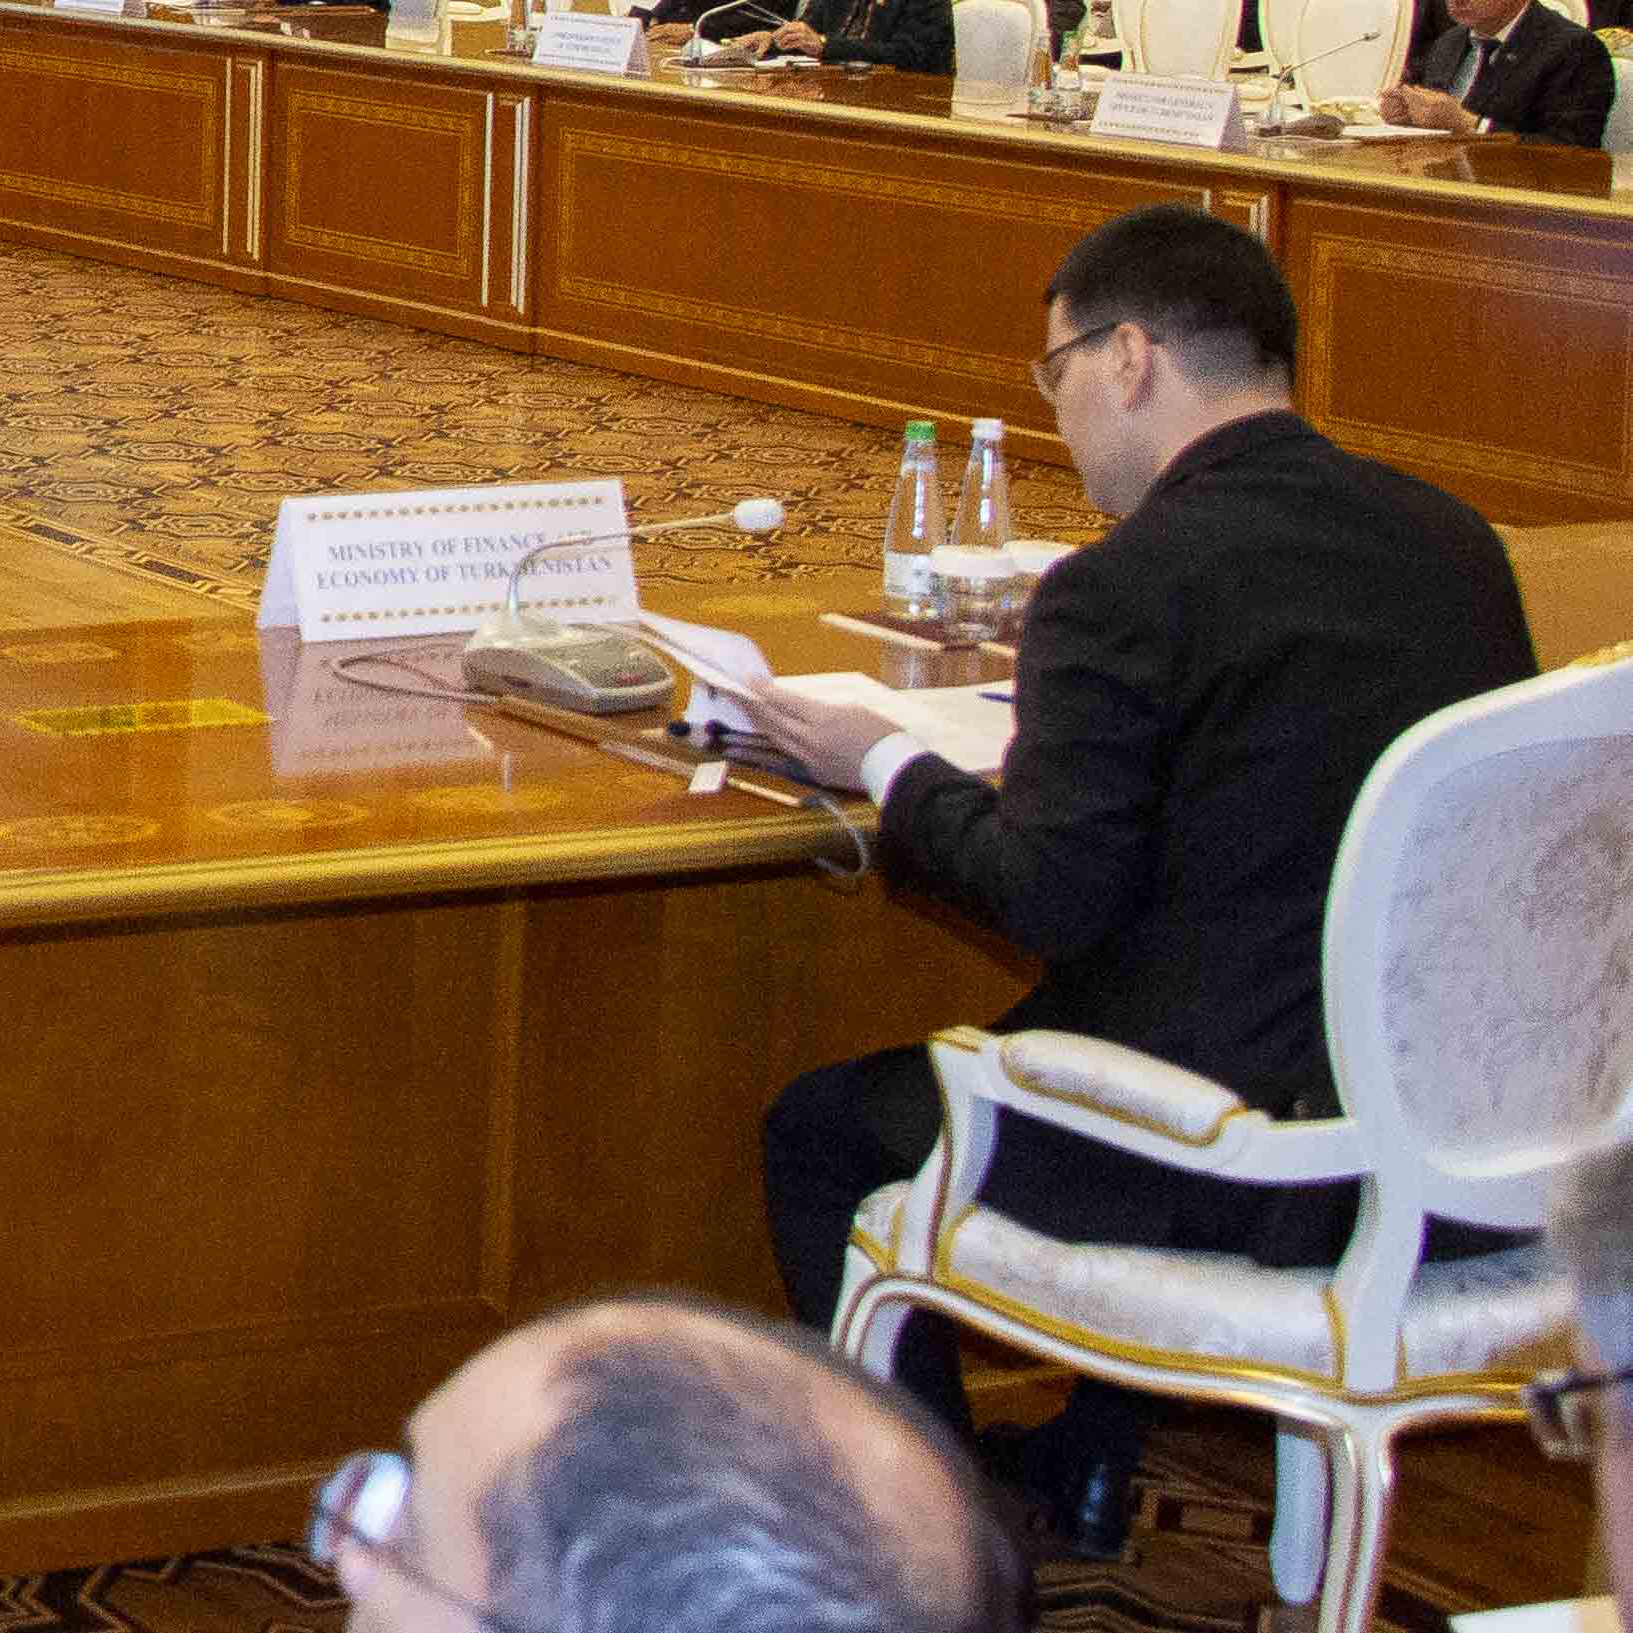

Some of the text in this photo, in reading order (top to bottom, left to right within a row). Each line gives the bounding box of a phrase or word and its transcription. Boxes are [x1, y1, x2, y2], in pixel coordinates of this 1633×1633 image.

[327, 540, 424, 562] MINISTRY
[431, 538, 457, 556] OF
[316, 568, 418, 591] ECONOMY
[425, 565, 449, 582] OF
